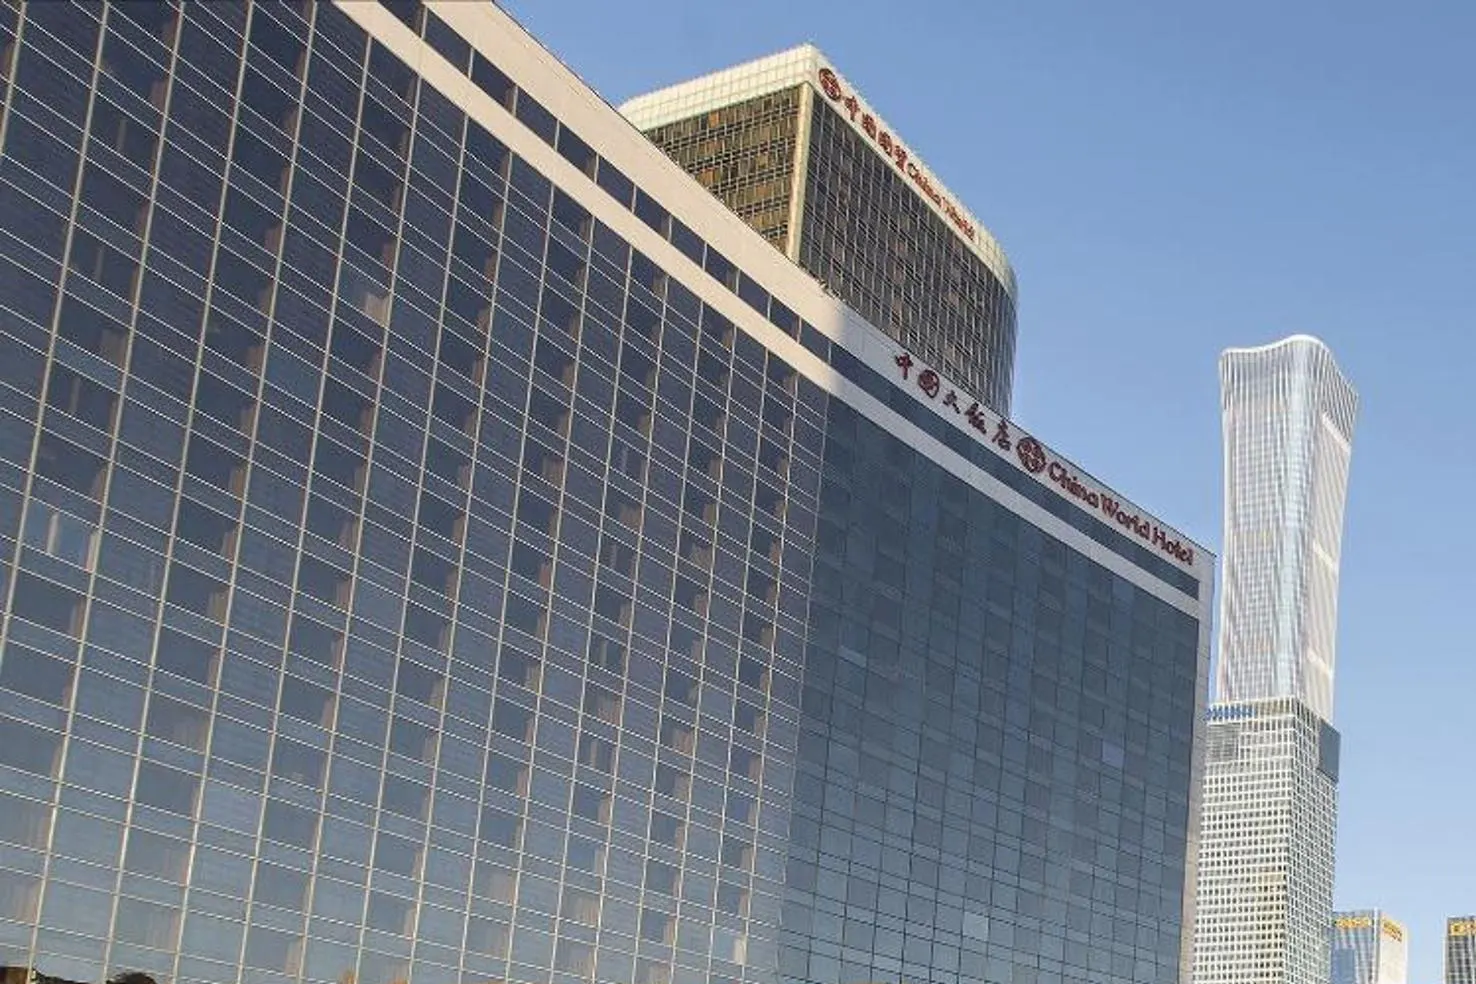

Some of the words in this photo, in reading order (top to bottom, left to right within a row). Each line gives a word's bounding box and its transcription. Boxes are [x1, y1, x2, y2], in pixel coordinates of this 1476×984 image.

[1049, 461, 1099, 508] China
[1100, 493, 1150, 540] World
[1152, 527, 1194, 566] Hotel
